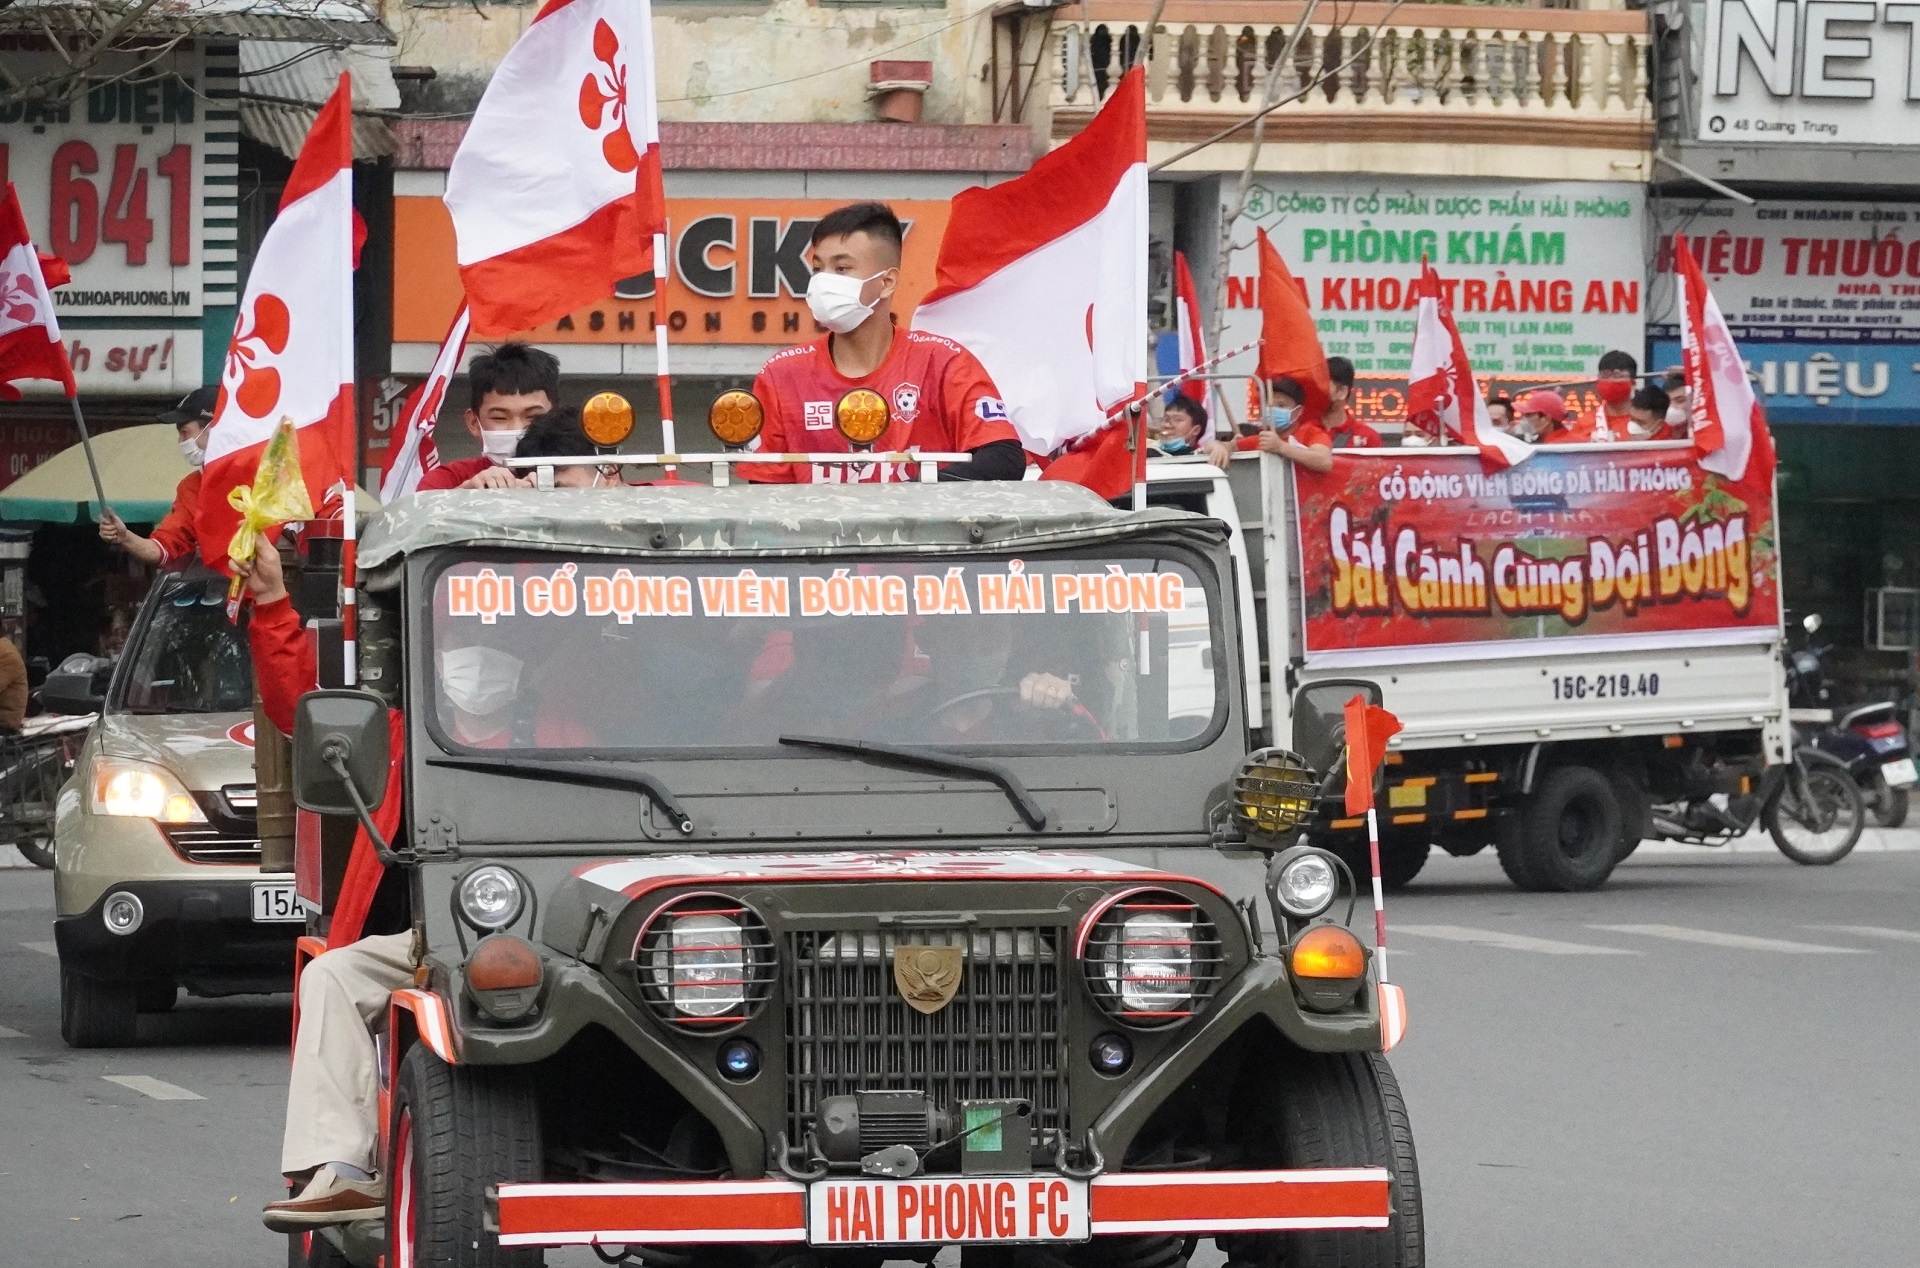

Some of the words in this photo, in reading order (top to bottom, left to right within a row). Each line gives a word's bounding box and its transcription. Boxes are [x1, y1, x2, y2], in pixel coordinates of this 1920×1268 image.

[1755, 119, 1796, 135] Quang
[1802, 120, 1839, 136] Trung
[49, 140, 192, 267] 641
[1276, 191, 1327, 213] CÔNG
[1332, 197, 1351, 214] TY
[1354, 186, 1381, 214] CỔ
[1385, 189, 1429, 215] PHẦN
[1541, 194, 1569, 217] HẢI
[1575, 195, 1632, 218] PHÒNG
[1302, 219, 1438, 264] PHÒNG
[1447, 222, 1566, 265] KHÁM
[1656, 228, 1765, 282] HIỆU
[54, 290, 191, 306] TAXIHOAPHUONG.VN
[1582, 279, 1640, 315] AN
[530, 309, 721, 333] ASHION
[806, 404, 832, 416] JG
[806, 416, 832, 428] BL
[1379, 464, 1407, 501] CỔ
[1511, 467, 1564, 497] BÓNG
[1628, 462, 1693, 492] PHÒNG
[1329, 506, 1390, 610] Sát
[1394, 528, 1488, 610] Cánh
[1493, 547, 1585, 620] Cùng
[1589, 533, 1650, 610] Đội
[1655, 516, 1746, 610] Bóng
[448, 568, 516, 625] HỘI
[522, 561, 579, 617] CỔ
[583, 568, 693, 625] ĐỘNG
[697, 568, 791, 618] VIÊN
[799, 568, 909, 617] BÓNG
[913, 566, 973, 616] ĐÁ
[977, 558, 1047, 615] HẢI
[1051, 563, 1187, 614] PHÒNG
[1552, 673, 1660, 700] 15C-219.40
[826, 1185, 885, 1242] HAI
[897, 1181, 1017, 1241] PHONG
[1028, 1180, 1069, 1238] FC
